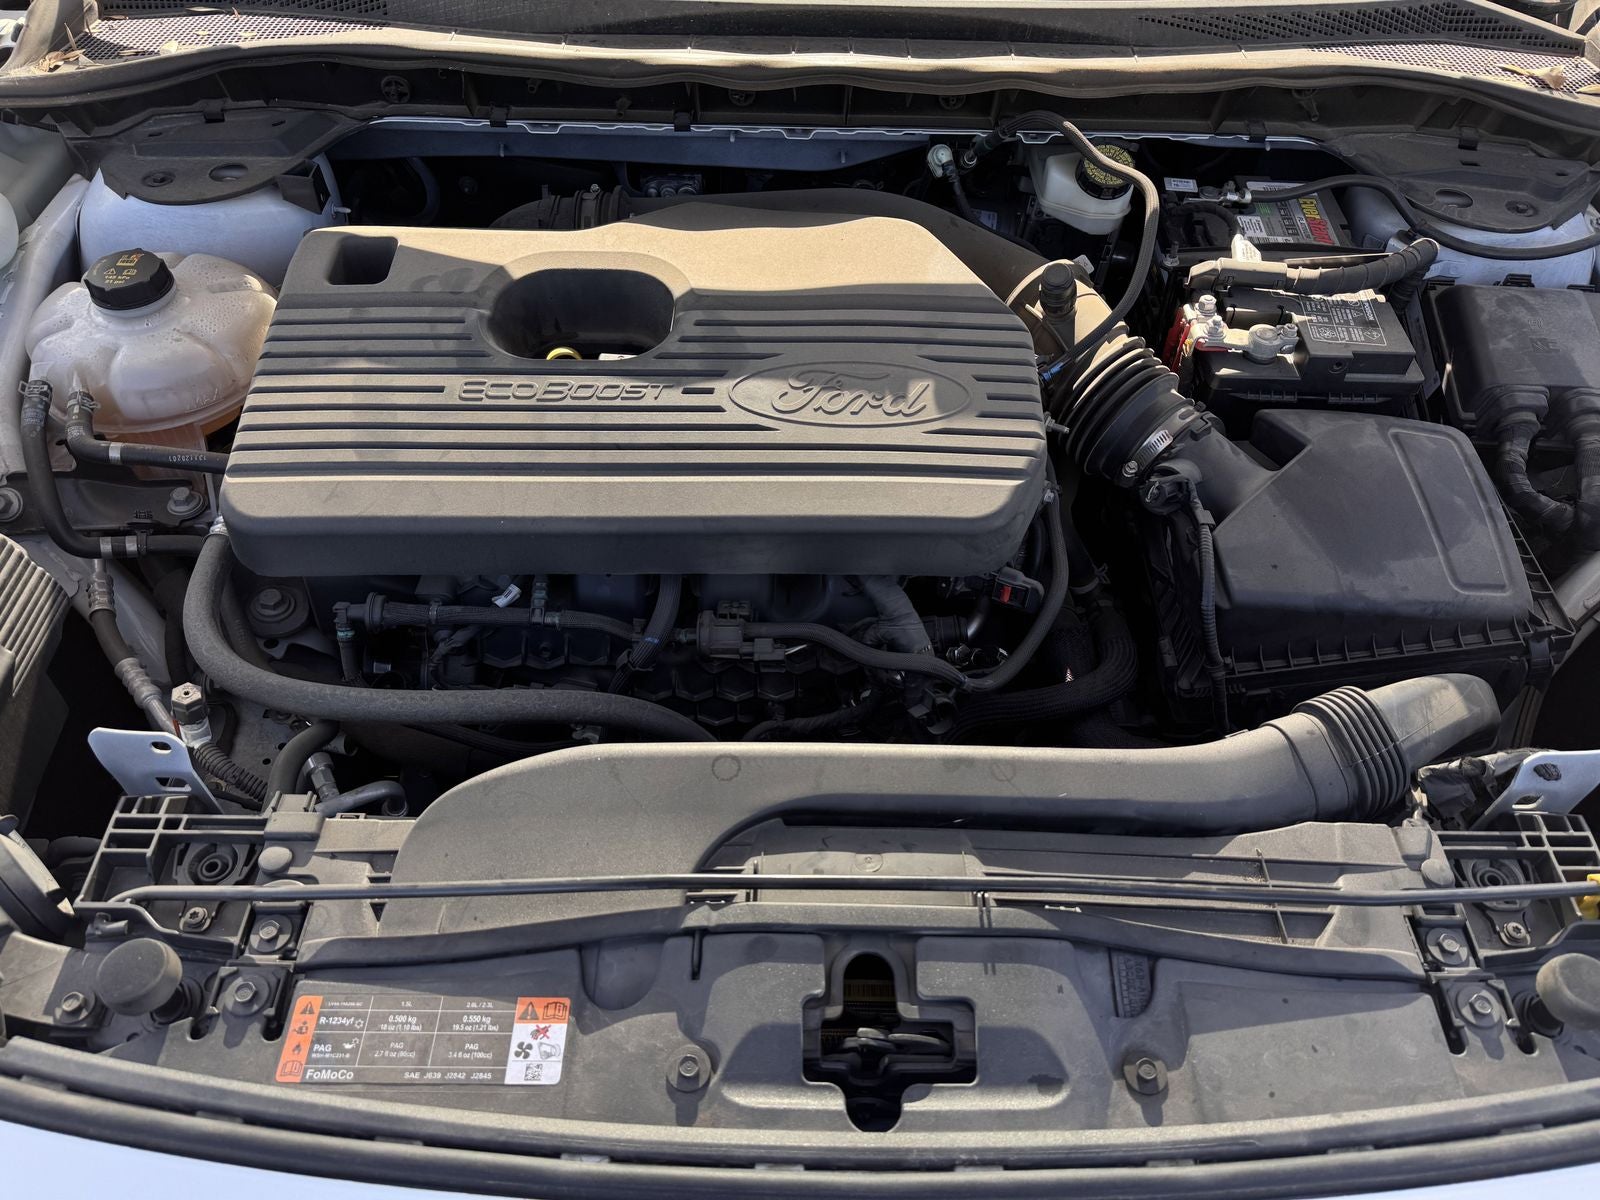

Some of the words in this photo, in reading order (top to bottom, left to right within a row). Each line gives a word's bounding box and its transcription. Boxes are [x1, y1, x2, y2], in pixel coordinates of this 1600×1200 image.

[771, 370, 931, 417] Ford
[319, 1016, 355, 1026] R-1234yf
[388, 1014, 407, 1023] 0.500
[407, 1015, 417, 1024] kg
[463, 1015, 481, 1023] 0.550
[482, 1016, 491, 1024] kg
[313, 1043, 332, 1052] PAG
[306, 1069, 354, 1080] FoMoCo
